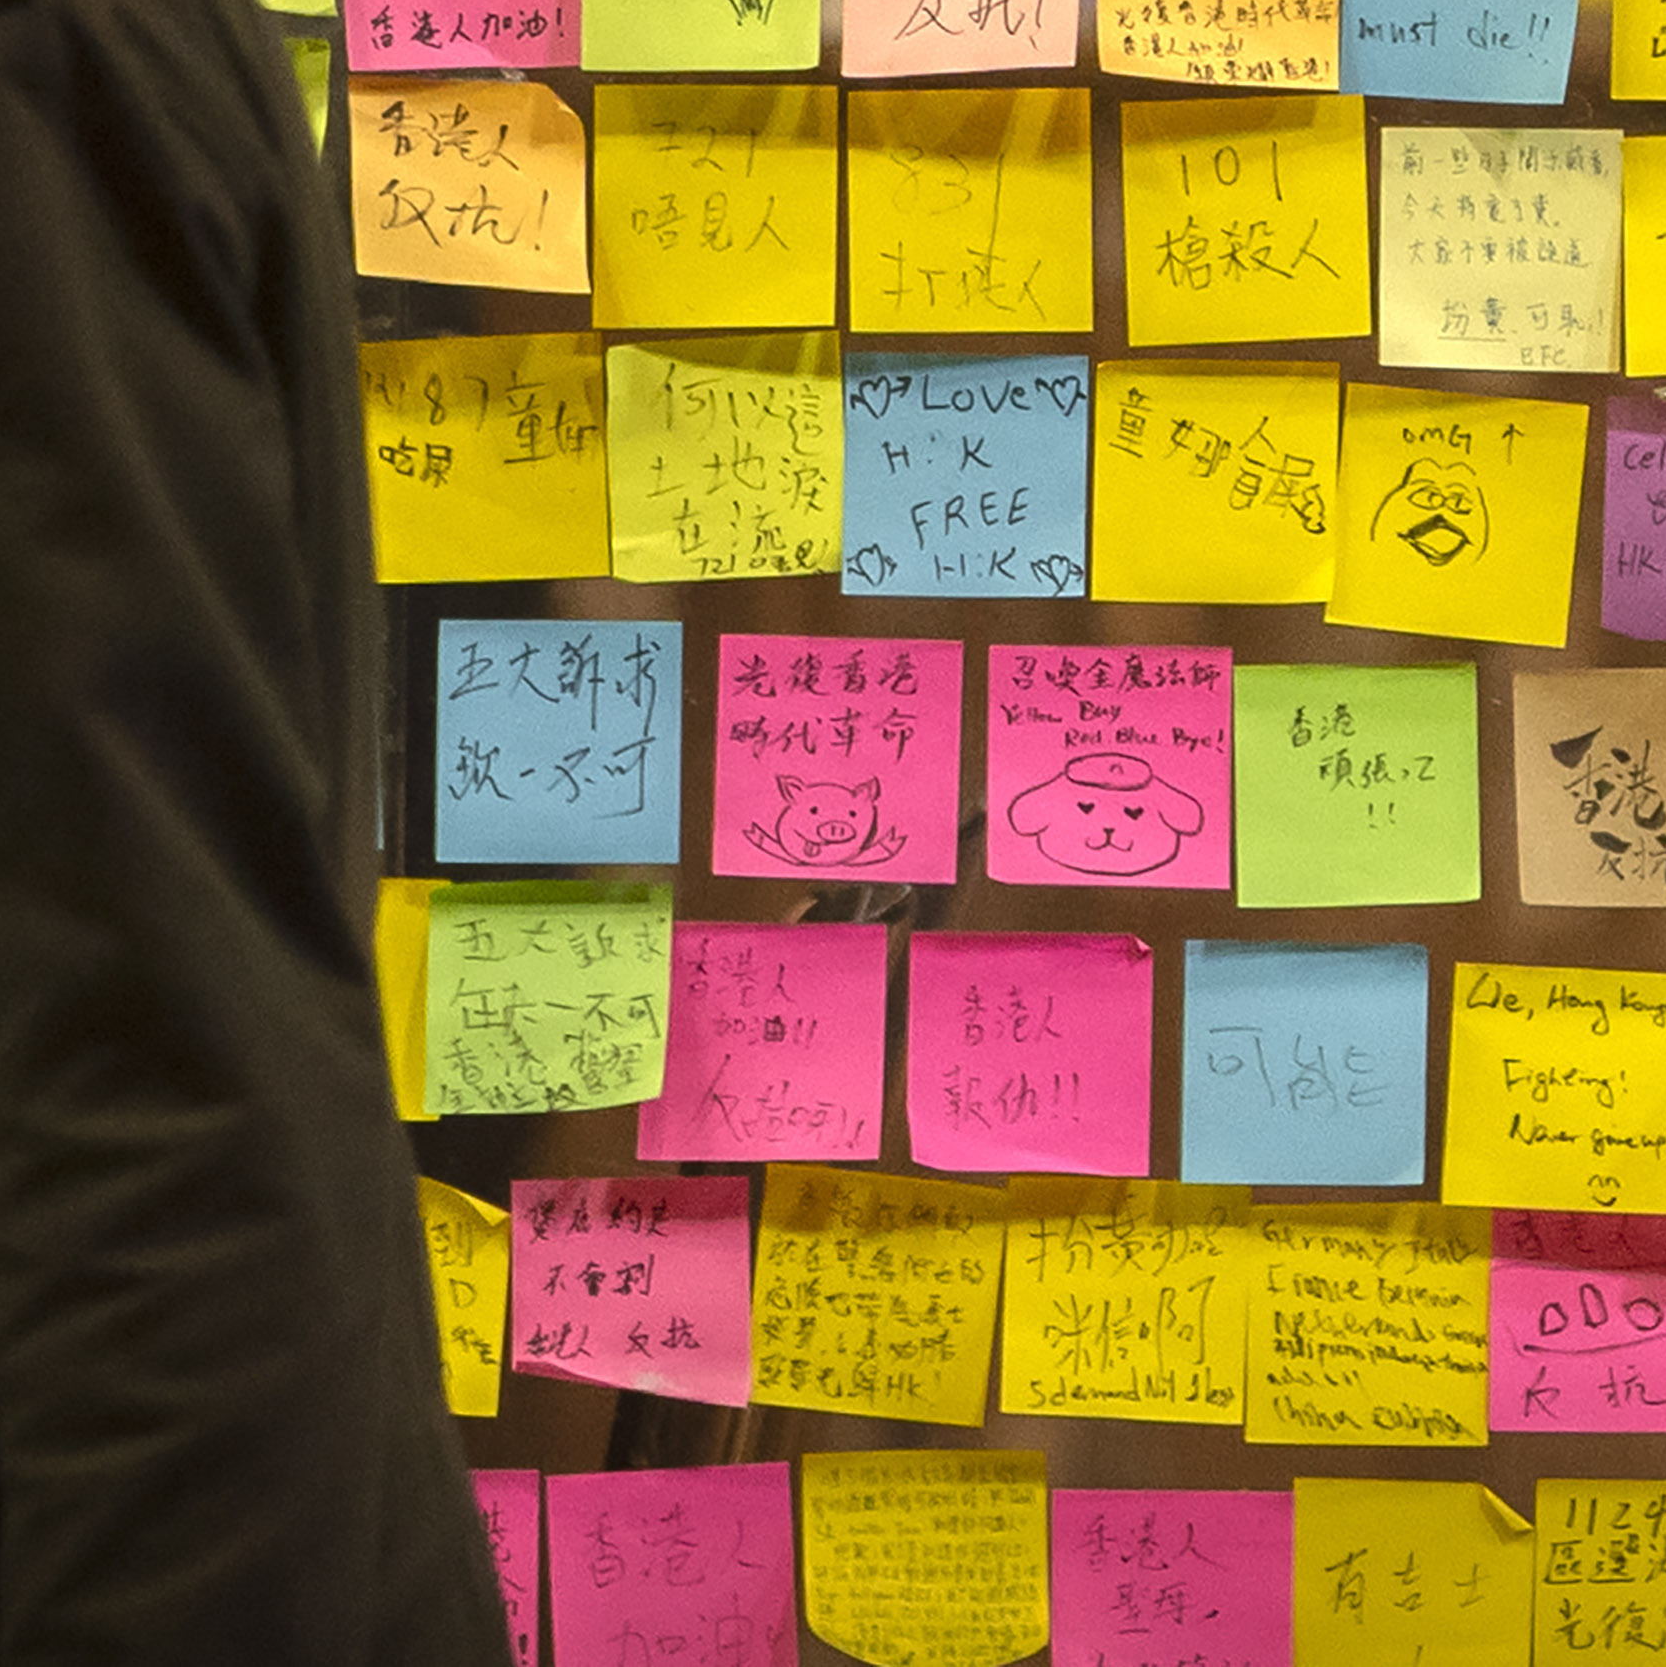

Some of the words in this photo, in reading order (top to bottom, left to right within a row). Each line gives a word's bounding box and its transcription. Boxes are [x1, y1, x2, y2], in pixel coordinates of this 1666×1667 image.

[1359, 19, 1439, 48] must
[1180, 141, 1280, 202] 101
[911, 486, 1031, 548] FREE
[1615, 544, 1659, 576] HK
